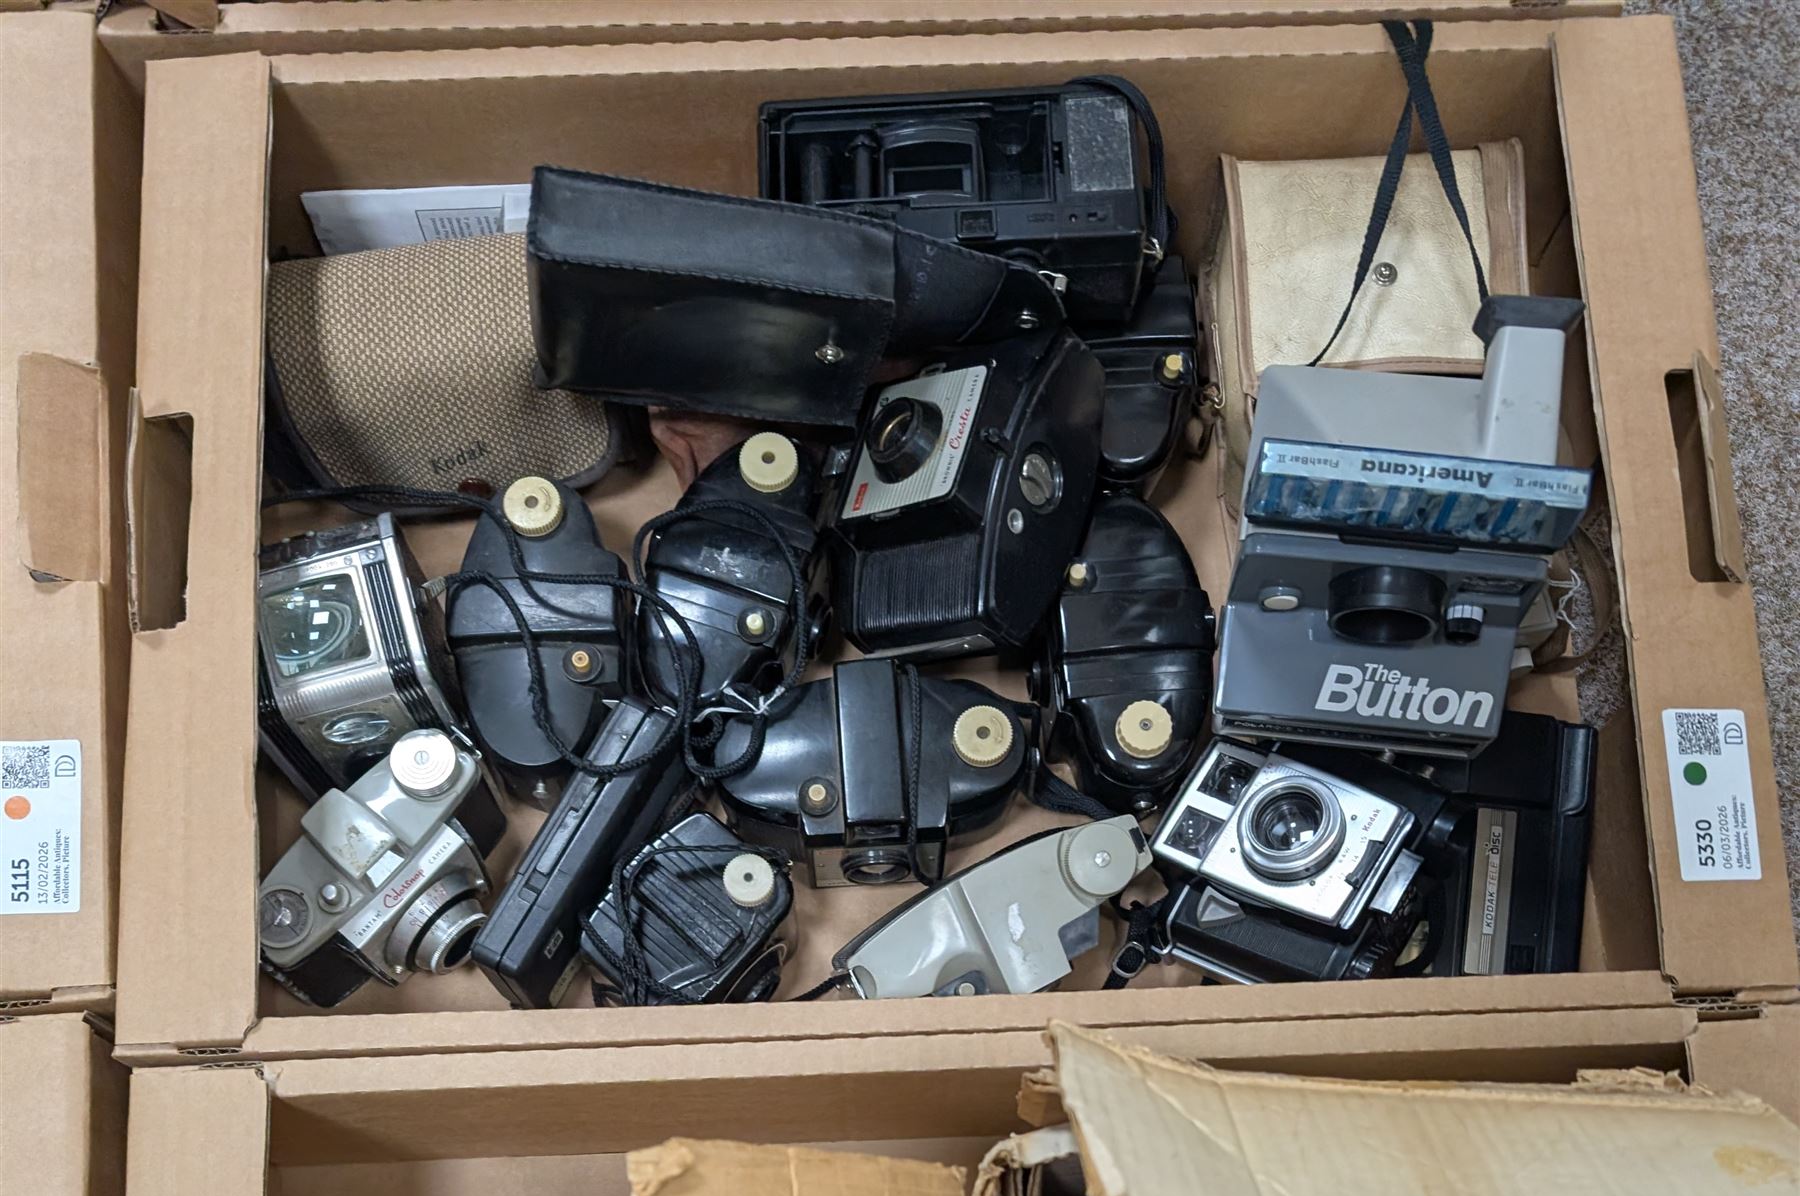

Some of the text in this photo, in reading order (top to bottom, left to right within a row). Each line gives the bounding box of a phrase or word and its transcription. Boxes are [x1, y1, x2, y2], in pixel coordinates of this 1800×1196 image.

[948, 406, 972, 450] Cresta
[1289, 454, 1339, 469] FlashBar
[1361, 459, 1493, 489] Americana
[1363, 663, 1401, 684] The
[1314, 663, 1495, 728] Button
[1362, 808, 1381, 832] Kodak
[1716, 804, 1733, 870] 06/03/2026
[62, 835, 70, 863] Picture
[1694, 818, 1716, 868] 5330
[10, 857, 30, 903] 5115
[37, 840, 49, 905] 13/02/2026
[53, 864, 62, 904] Affordable
[383, 868, 425, 909] Colorsnap
[1485, 891, 1496, 928] KODAK
